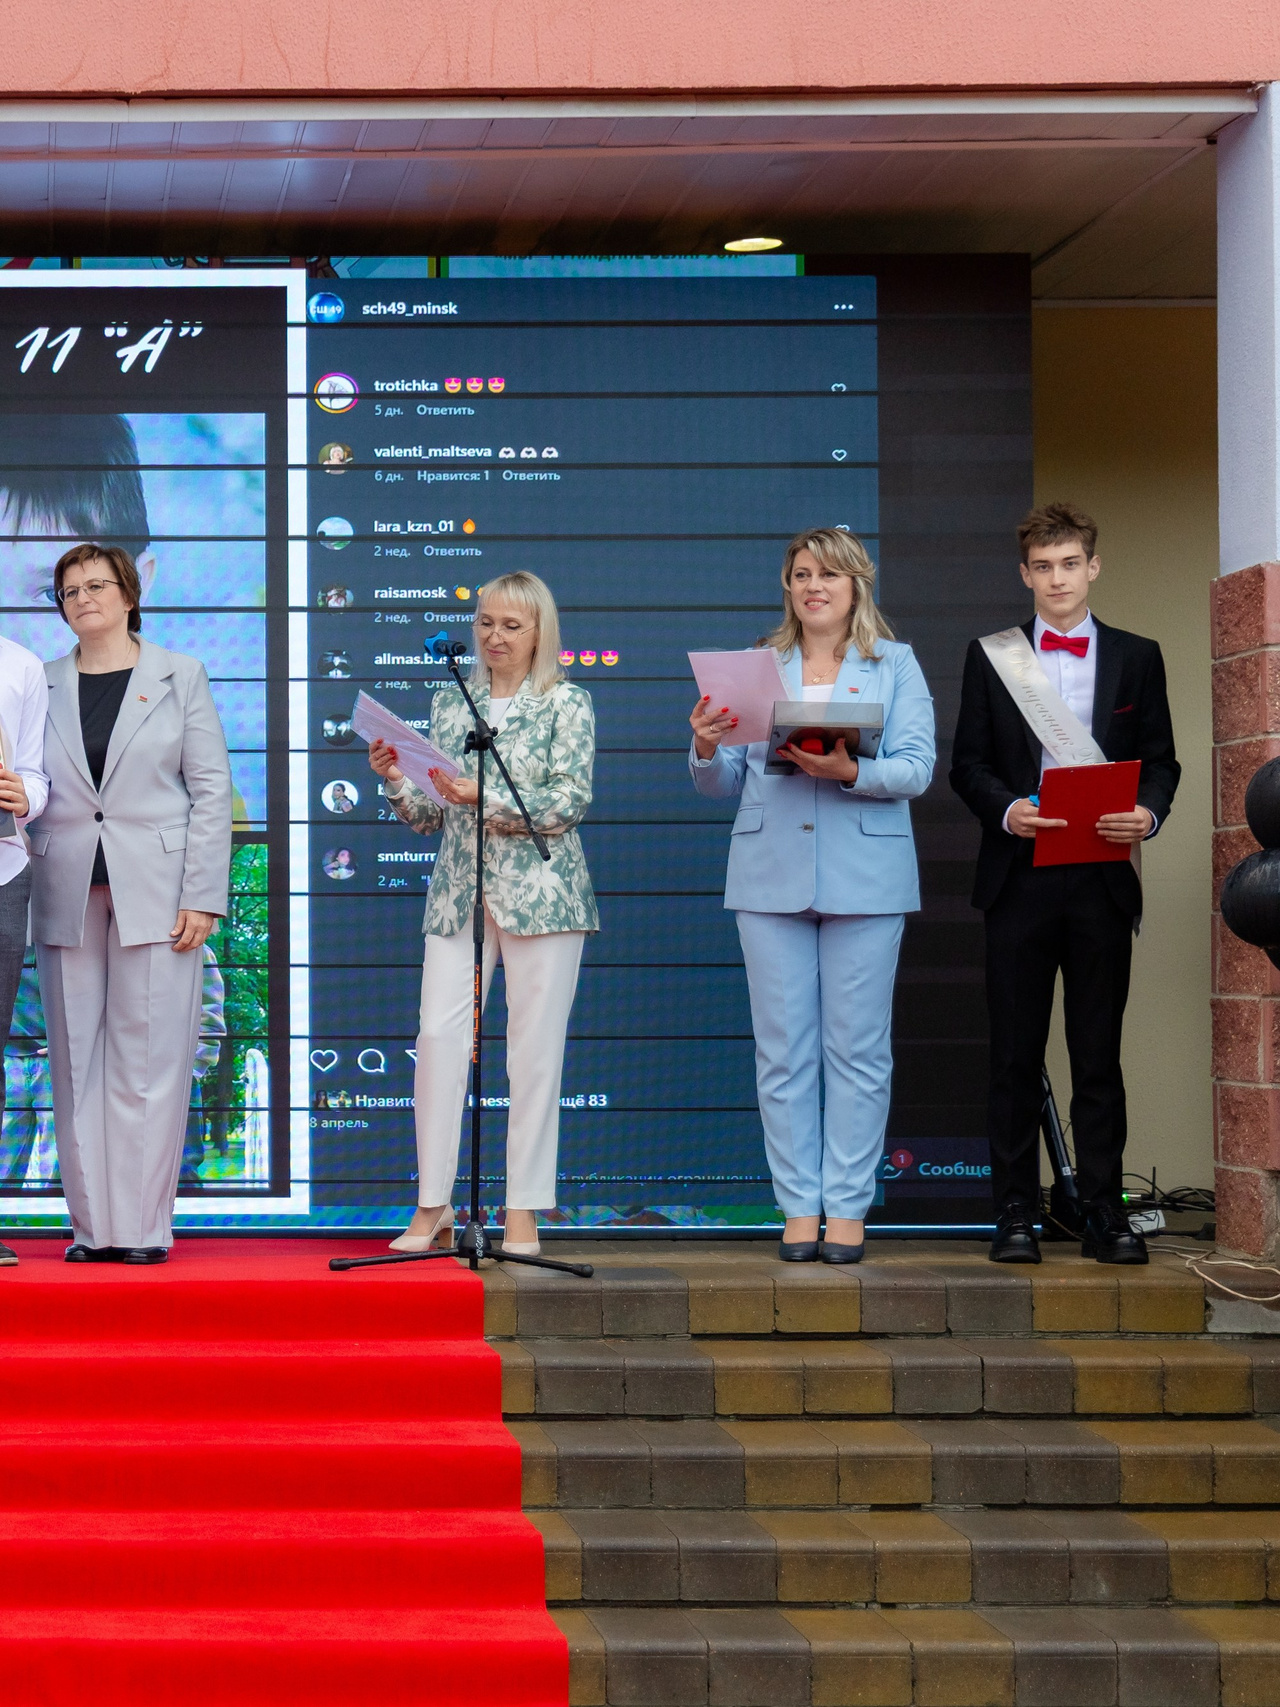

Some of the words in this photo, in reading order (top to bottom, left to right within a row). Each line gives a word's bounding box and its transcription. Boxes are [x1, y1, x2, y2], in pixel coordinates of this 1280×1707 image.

[362, 301, 458, 317] sch49_minsk
[16, 326, 81, 373] 11
[374, 379, 438, 391] trotichka
[374, 404, 382, 416] 5
[384, 406, 404, 417] дн.
[416, 404, 475, 416] Ответить
[374, 446, 492, 460] valenti_maltseva
[374, 471, 382, 481] 6
[385, 472, 404, 483] дн.
[417, 470, 480, 484] Нравится:
[483, 470, 489, 481] 1
[502, 470, 561, 481] Ответить
[374, 520, 454, 534] lara_kzn_01
[374, 546, 382, 556] 2
[385, 547, 411, 558] нед.
[423, 545, 482, 556] Ответить
[374, 587, 448, 599] raisamosk
[374, 611, 382, 623] 2
[385, 613, 411, 625] нед.
[424, 611, 475, 623] Ответит
[377, 809, 386, 820] 2
[377, 875, 386, 886] 2
[388, 878, 408, 888] дн.
[588, 1094, 608, 1107] 83
[321, 1119, 369, 1131] апрель
[918, 1161, 991, 1177] Сообще
